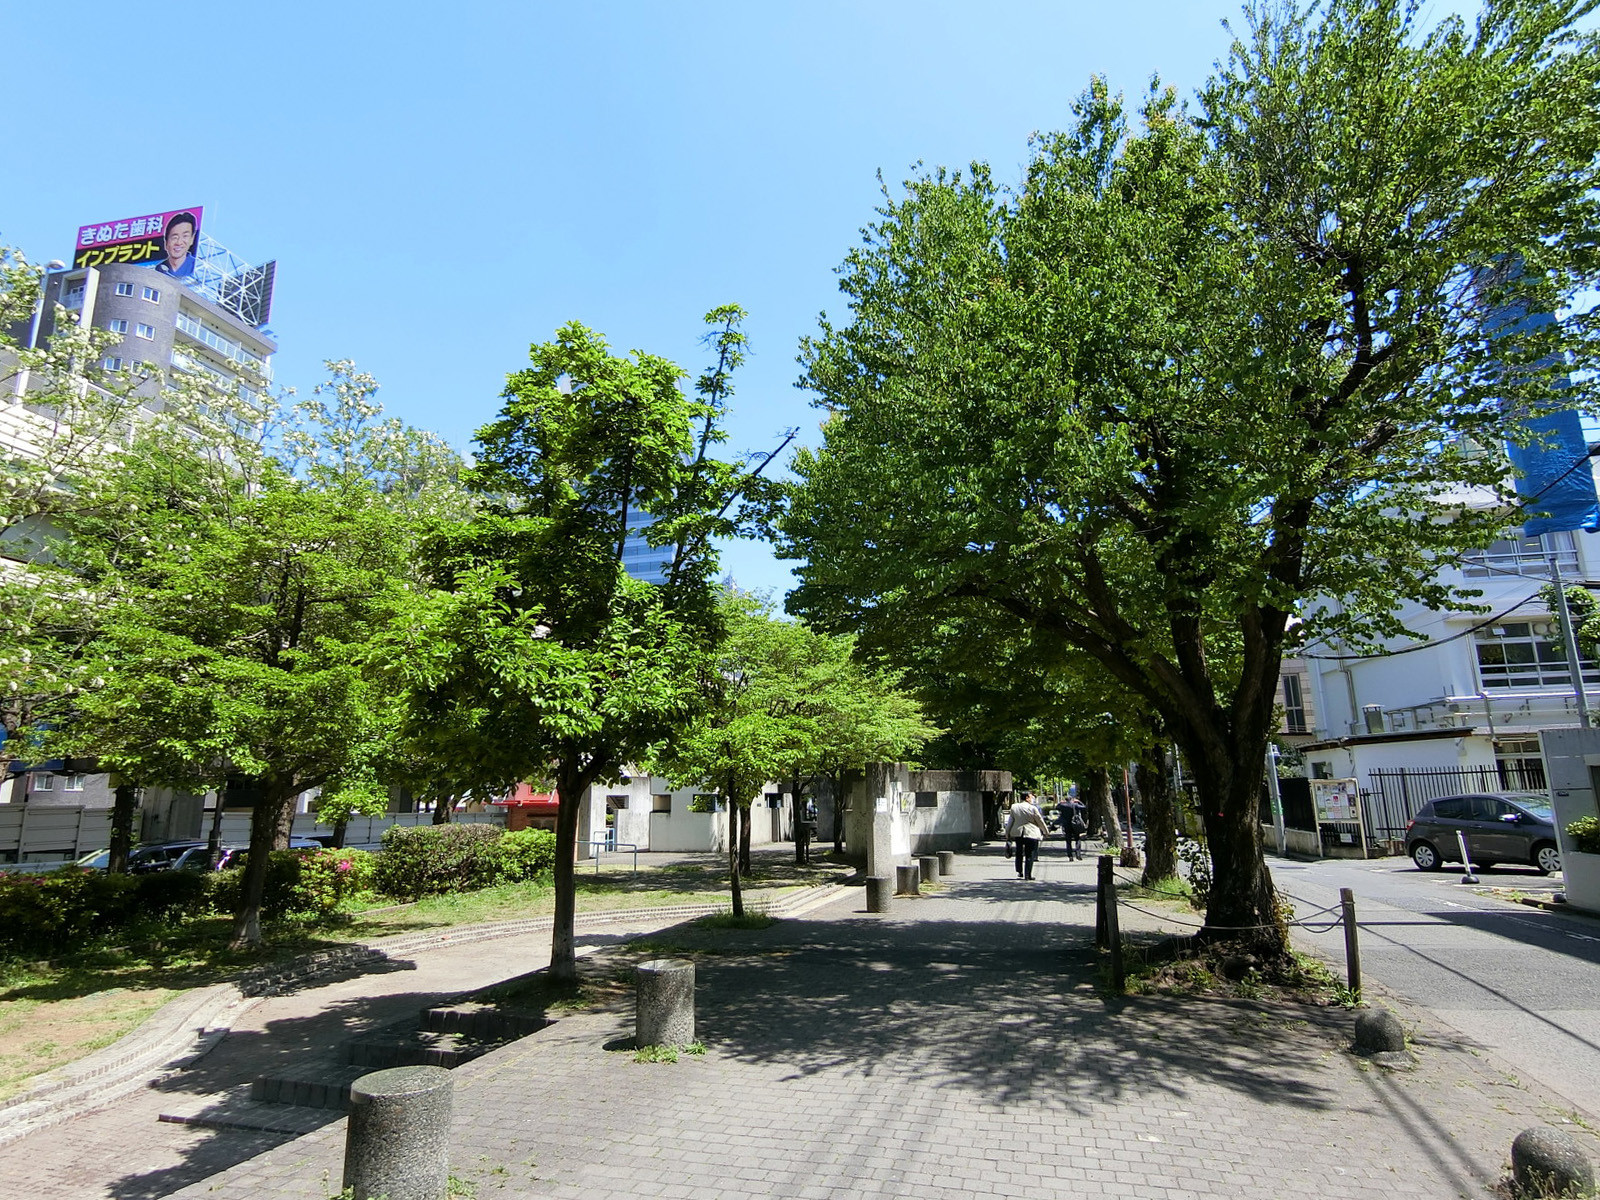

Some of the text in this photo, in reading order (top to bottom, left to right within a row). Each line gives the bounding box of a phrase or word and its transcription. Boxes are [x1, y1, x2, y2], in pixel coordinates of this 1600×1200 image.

[81, 215, 163, 245] きぬた歯科
[76, 240, 159, 267] インプラント
